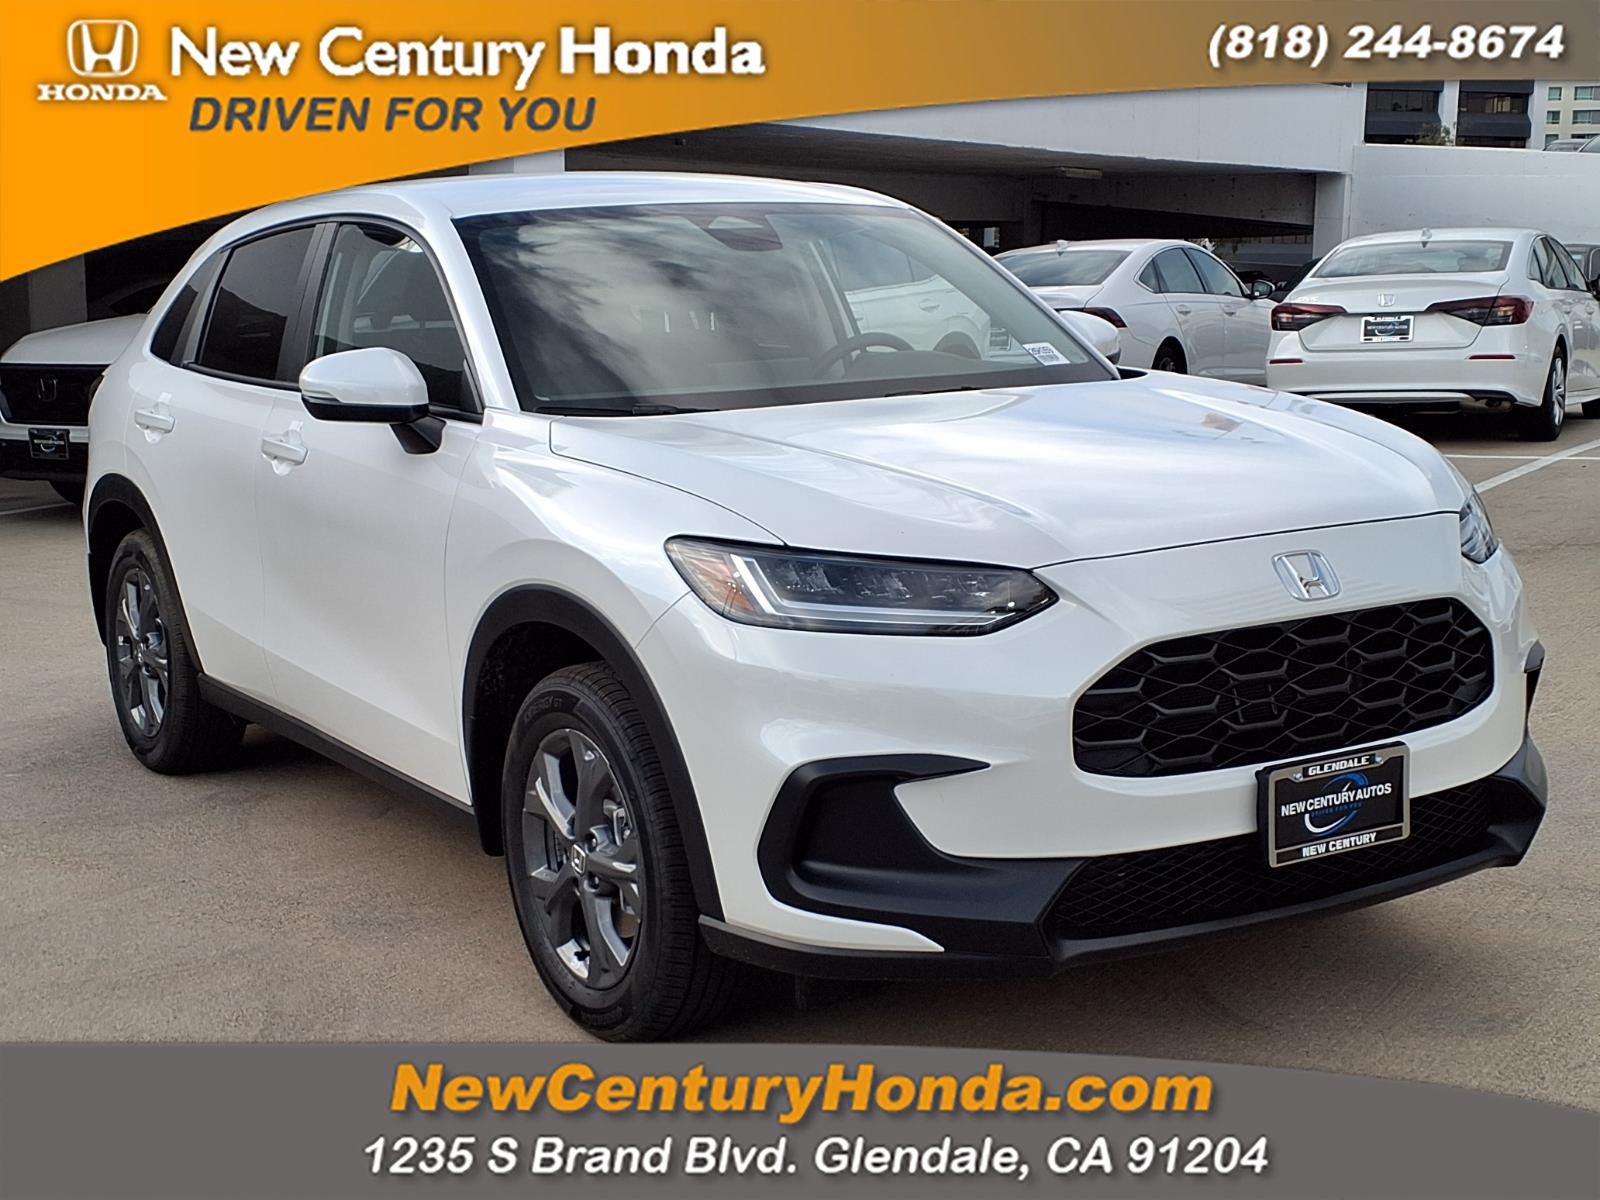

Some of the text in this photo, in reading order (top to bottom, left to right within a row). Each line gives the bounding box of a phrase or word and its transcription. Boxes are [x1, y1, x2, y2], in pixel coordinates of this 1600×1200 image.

[1308, 756, 1370, 776] GLENDALE
[1281, 801, 1307, 816] NEW
[1306, 790, 1357, 811] CENTURY
[1355, 782, 1392, 800] AUTOS
[1302, 832, 1377, 857] NEW CENTURY
